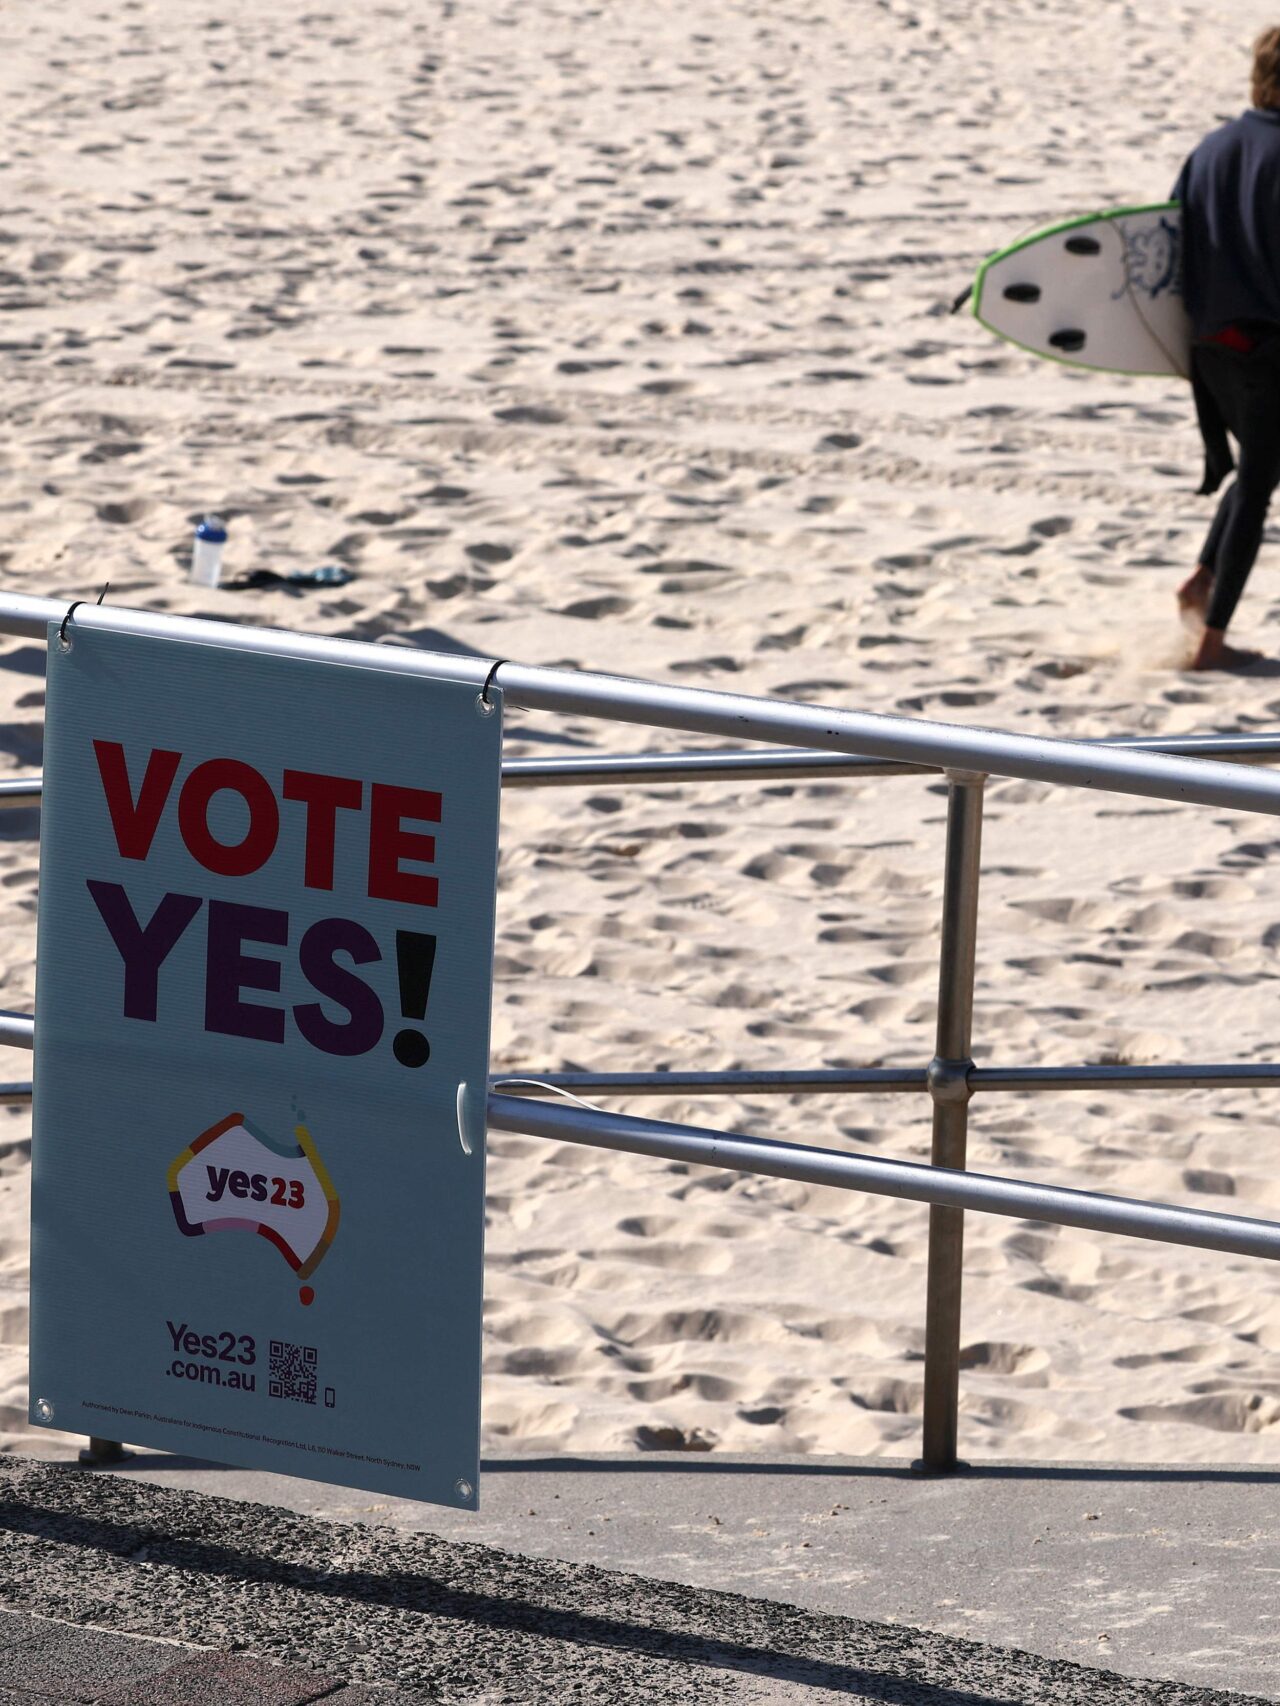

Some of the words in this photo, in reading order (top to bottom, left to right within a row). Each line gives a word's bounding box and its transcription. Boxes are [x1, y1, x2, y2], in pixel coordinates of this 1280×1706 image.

[92, 739, 443, 908] VOTE
[86, 879, 437, 1069] YES!
[205, 1165, 306, 1210] yes23
[166, 1320, 257, 1366] Yes23
[165, 1360, 257, 1393] .com.au
[154, 1415, 183, 1425] Australians
[193, 1422, 221, 1434] Indigenous
[223, 1428, 260, 1440] Constitutional
[263, 1436, 296, 1449] Recognition
[366, 1456, 382, 1464] North
[407, 1464, 420, 1472] NSW
